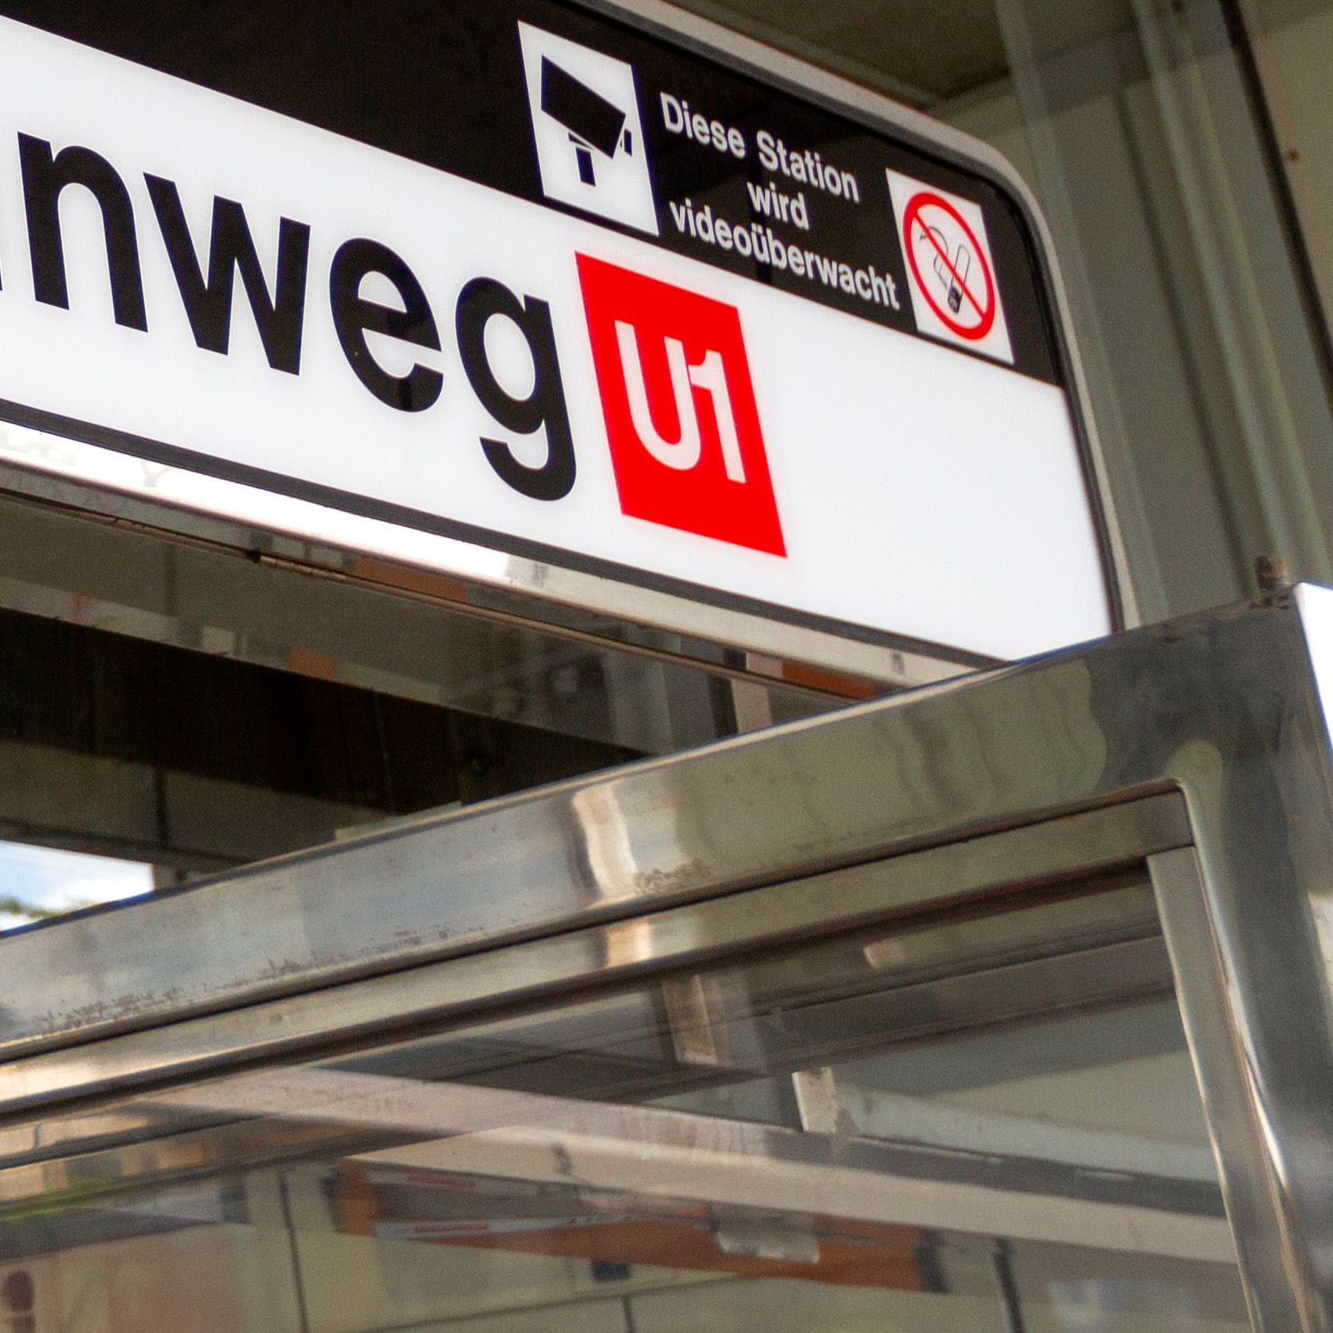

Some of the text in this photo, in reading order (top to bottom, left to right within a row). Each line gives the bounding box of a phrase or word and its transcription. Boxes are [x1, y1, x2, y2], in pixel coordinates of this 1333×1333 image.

[659, 92, 860, 203] Diese Station
[669, 199, 900, 311] videoüberwacht
[746, 181, 810, 230] wird
[614, 320, 746, 484] U1
